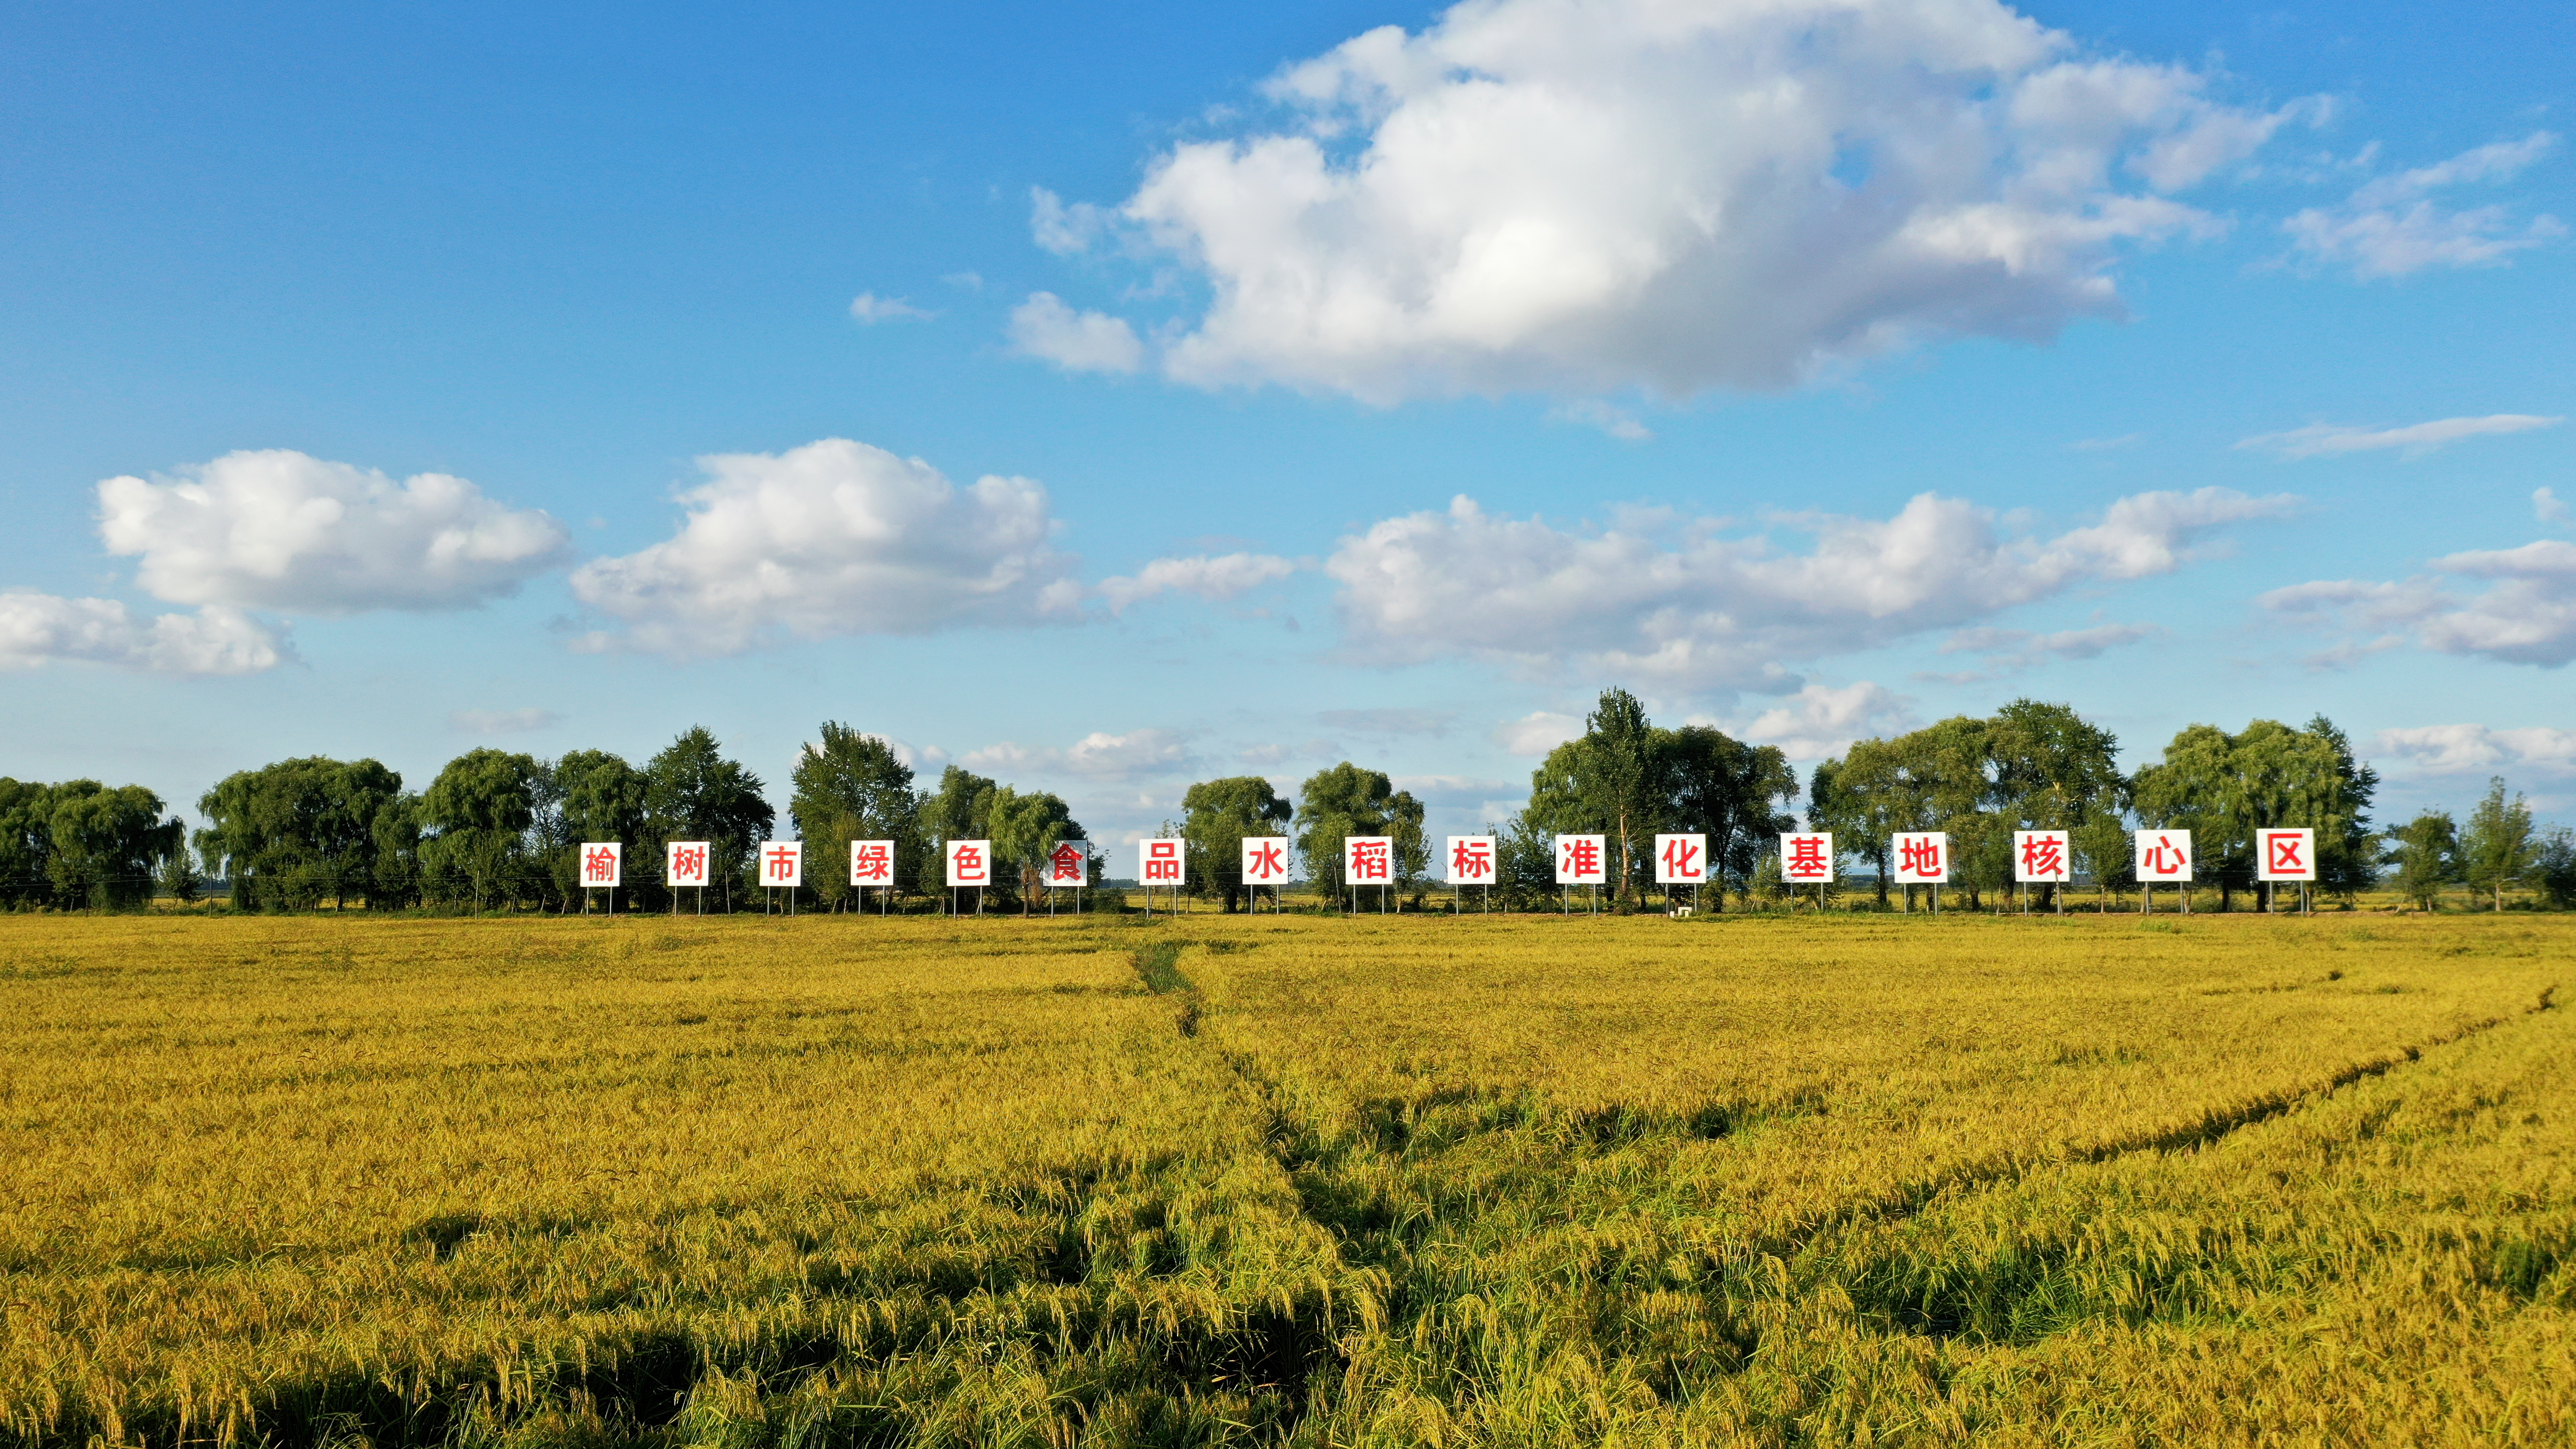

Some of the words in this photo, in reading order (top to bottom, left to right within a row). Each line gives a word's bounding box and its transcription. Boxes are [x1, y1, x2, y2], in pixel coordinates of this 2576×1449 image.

[586, 846, 617, 882] 榆
[672, 846, 706, 881] 树
[766, 846, 797, 881] 市
[856, 845, 889, 880] 绿
[952, 845, 985, 880] 色
[1051, 843, 1084, 881] 食
[1146, 842, 1179, 879] 品
[1248, 841, 1284, 879] 水
[1351, 840, 1387, 879] 稻
[1453, 840, 1491, 878] 标
[1562, 839, 1600, 878] 准
[1662, 839, 1701, 878] 化
[1788, 837, 1827, 877] 基
[1900, 837, 1942, 877] 地
[2022, 835, 2064, 876] 核
[2144, 836, 2186, 875] 心
[2268, 833, 2307, 875] 区
